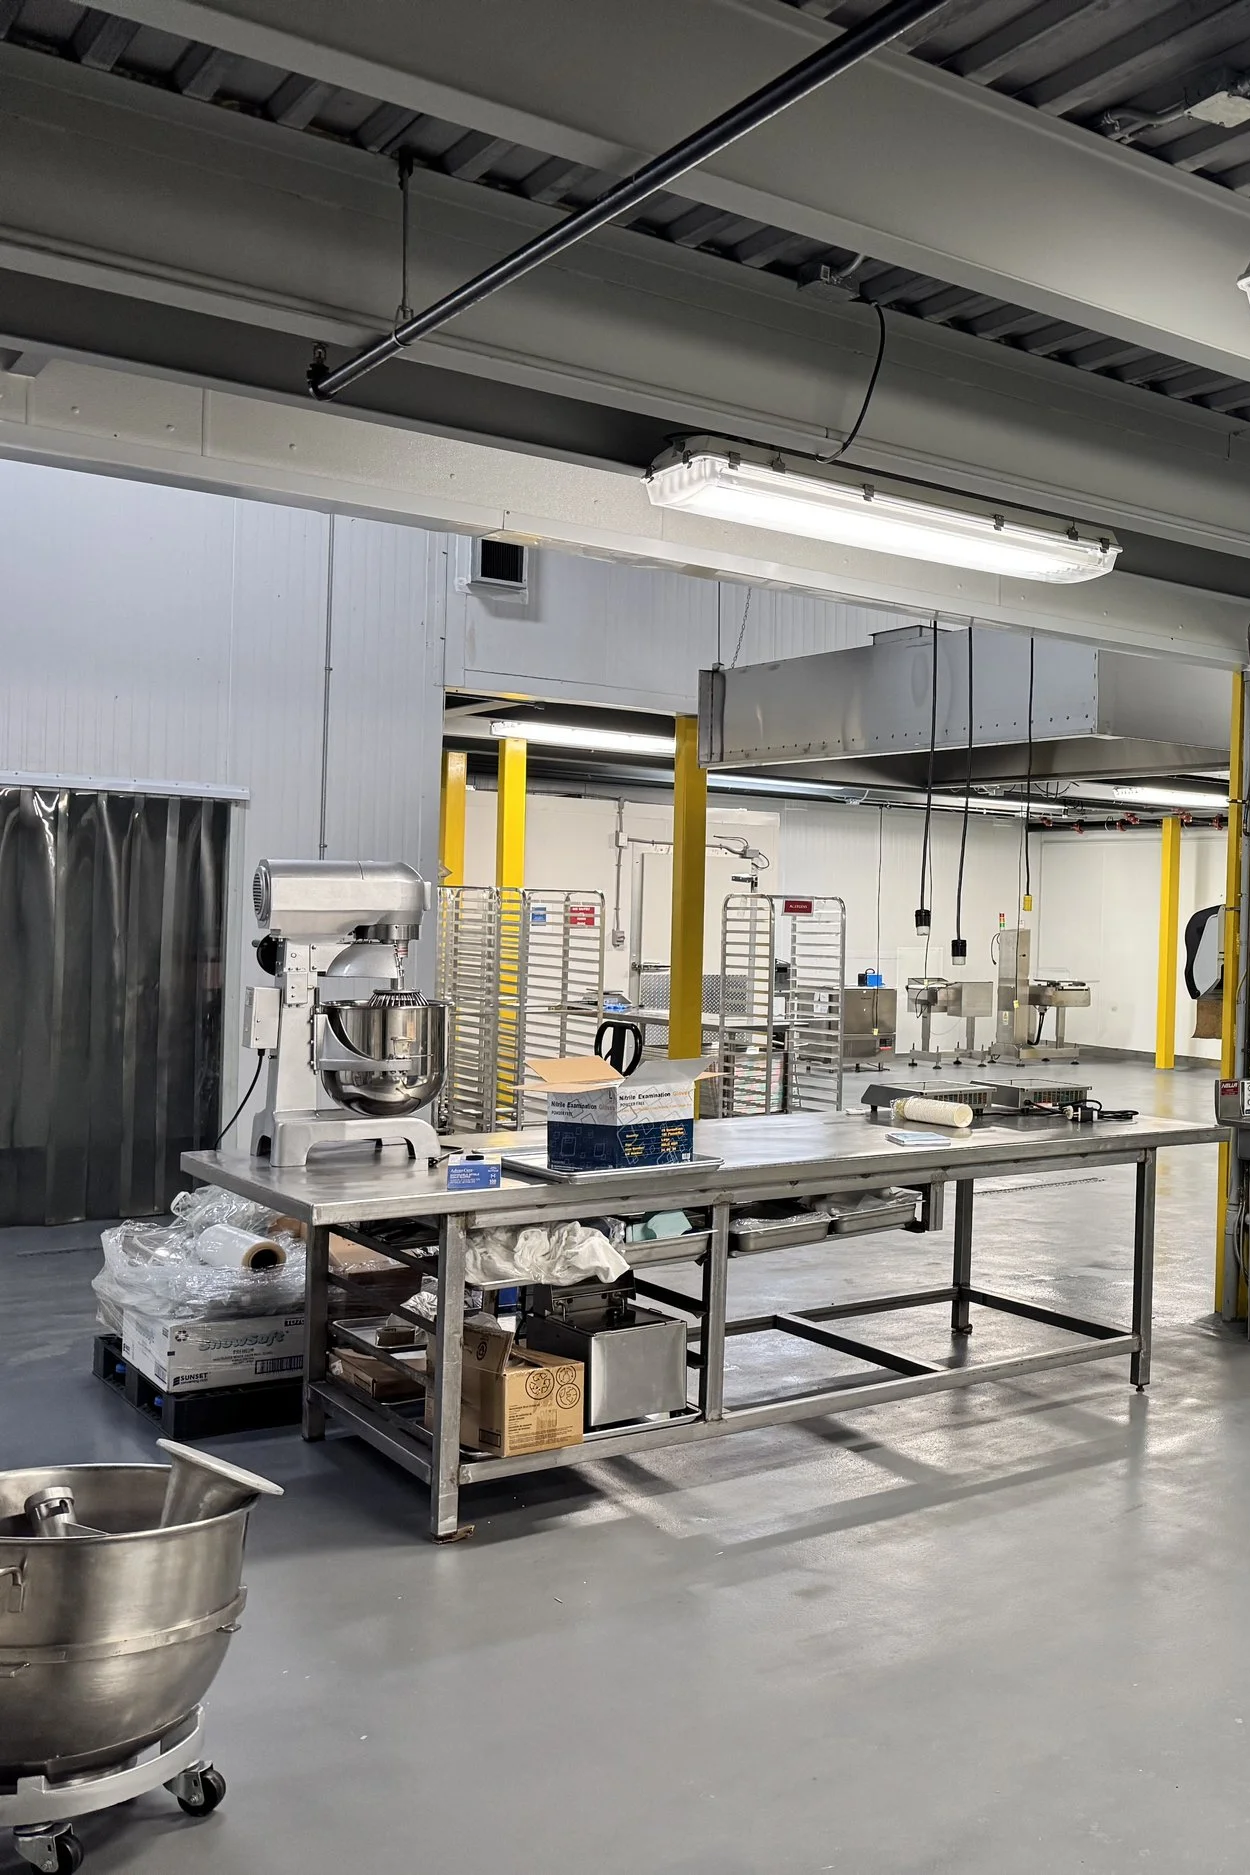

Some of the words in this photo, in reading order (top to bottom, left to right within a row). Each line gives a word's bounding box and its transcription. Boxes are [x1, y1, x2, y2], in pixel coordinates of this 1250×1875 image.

[638, 1092, 671, 1100] Examination
[567, 1101, 597, 1110] Examination
[180, 1372, 208, 1381] SUNSET
